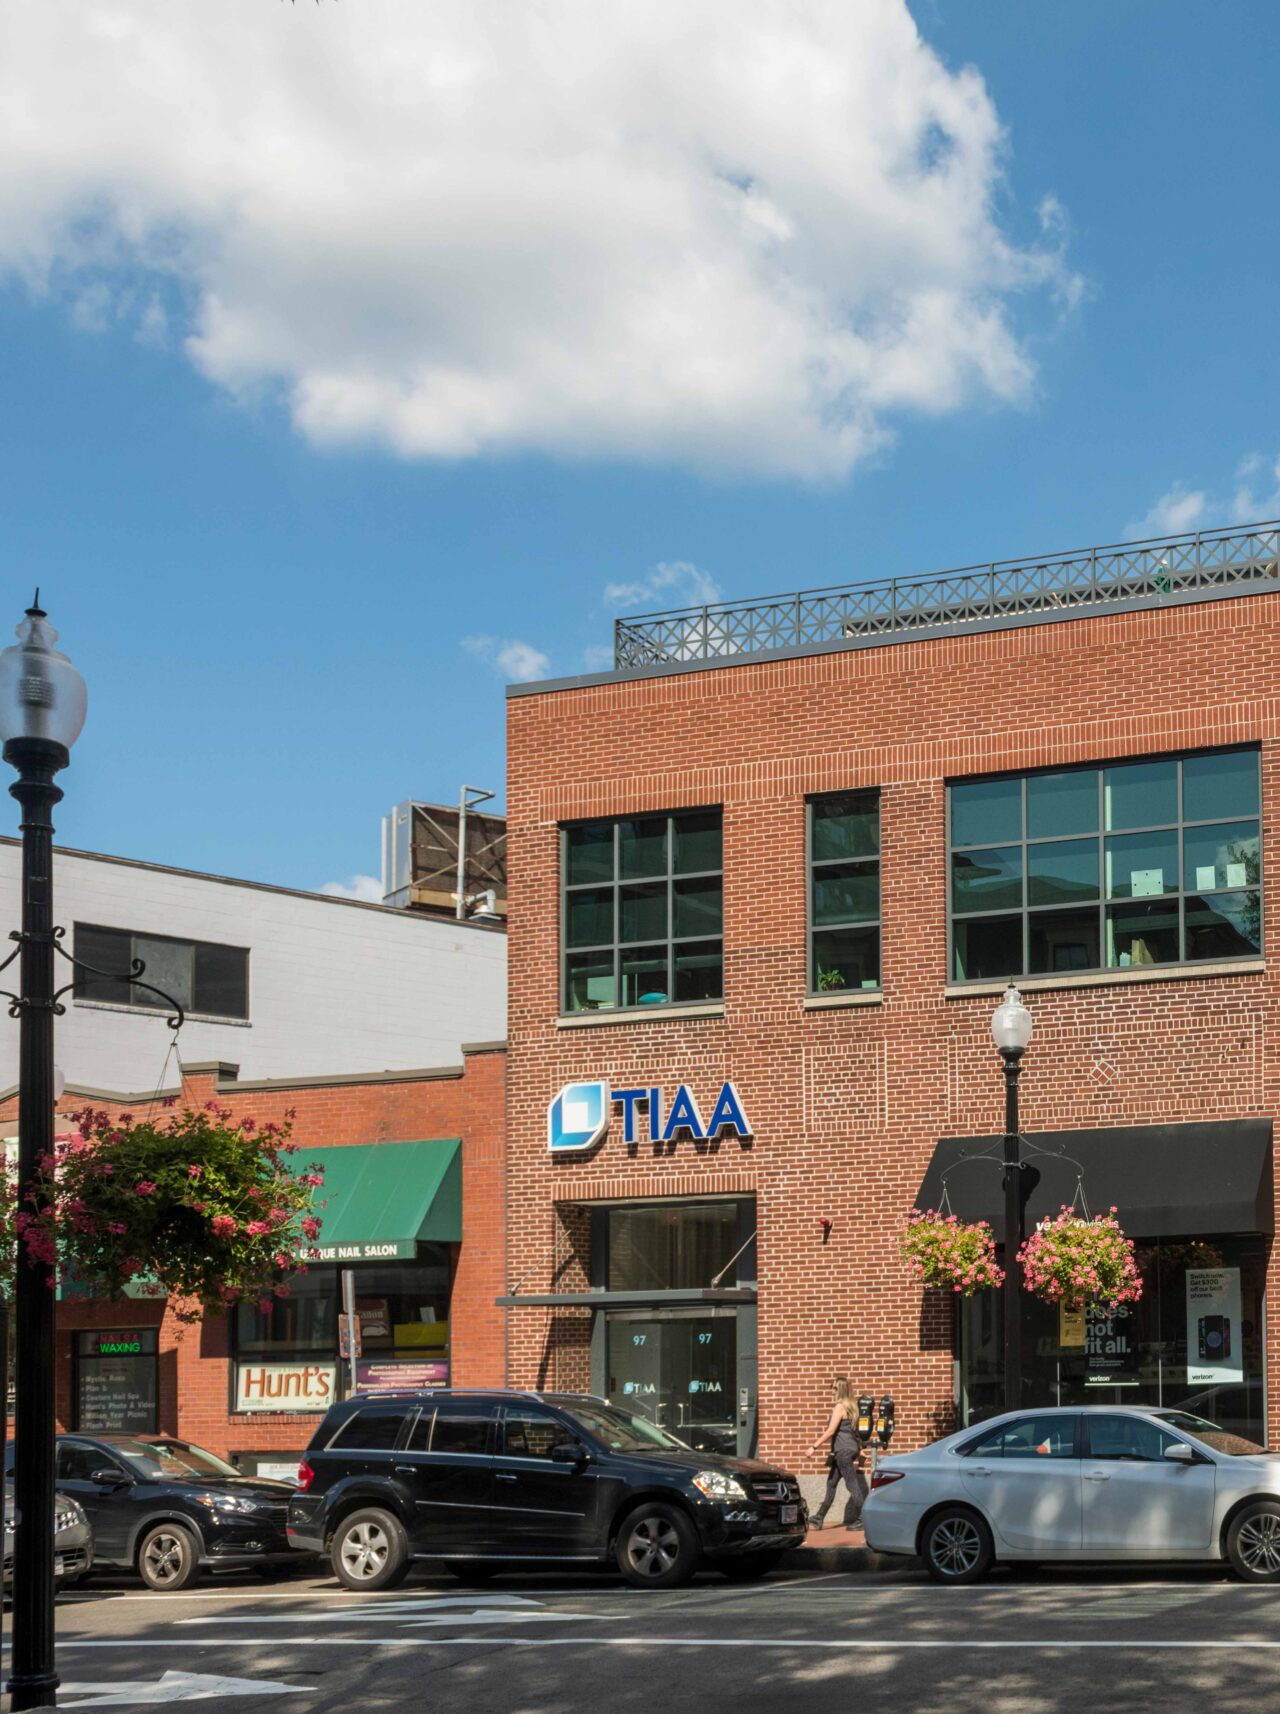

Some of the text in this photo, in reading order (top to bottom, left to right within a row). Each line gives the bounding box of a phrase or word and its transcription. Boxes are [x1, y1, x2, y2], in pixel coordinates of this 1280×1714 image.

[611, 1081, 753, 1143] TIAA
[300, 1247, 336, 1260] UQUE
[338, 1246, 361, 1258] NAIL
[364, 1244, 398, 1257] SALON
[1085, 1320, 1113, 1336] not
[633, 1335, 646, 1345] 97
[698, 1333, 712, 1344] 97
[1105, 1336, 1131, 1353] all.
[100, 1342, 141, 1353] WAXING
[244, 1365, 330, 1398] Hunt's
[700, 1381, 722, 1392] TIAA
[634, 1383, 656, 1394] TIAA
